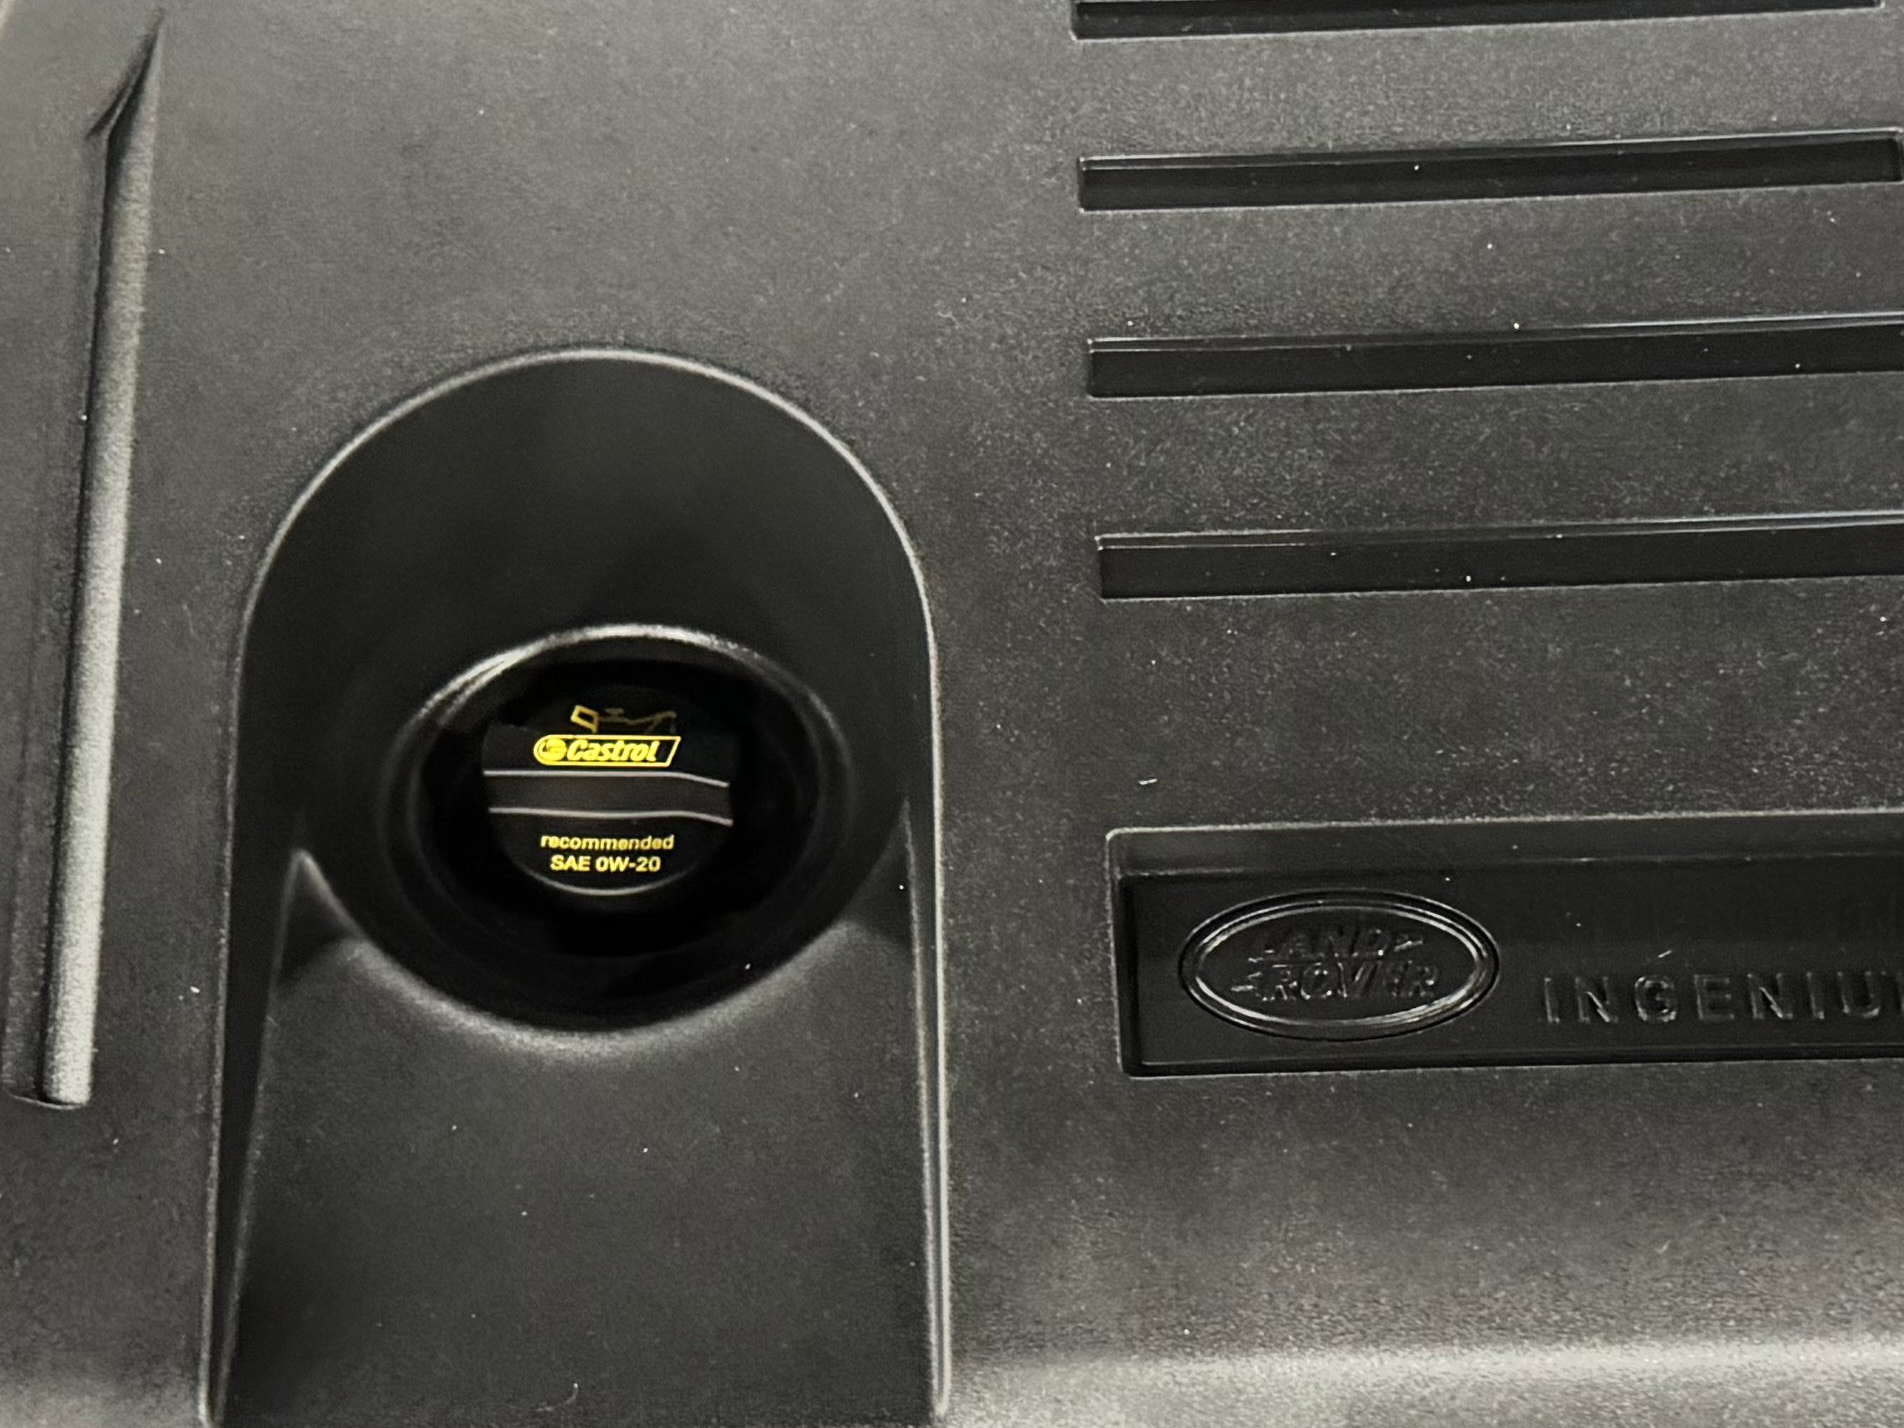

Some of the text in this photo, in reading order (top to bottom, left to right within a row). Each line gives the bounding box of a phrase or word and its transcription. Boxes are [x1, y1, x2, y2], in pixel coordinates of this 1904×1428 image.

[566, 738, 661, 763] Castrol
[540, 834, 675, 852] recommended
[549, 854, 662, 873] SAE 0W-20
[1254, 958, 1440, 1002] ROVER
